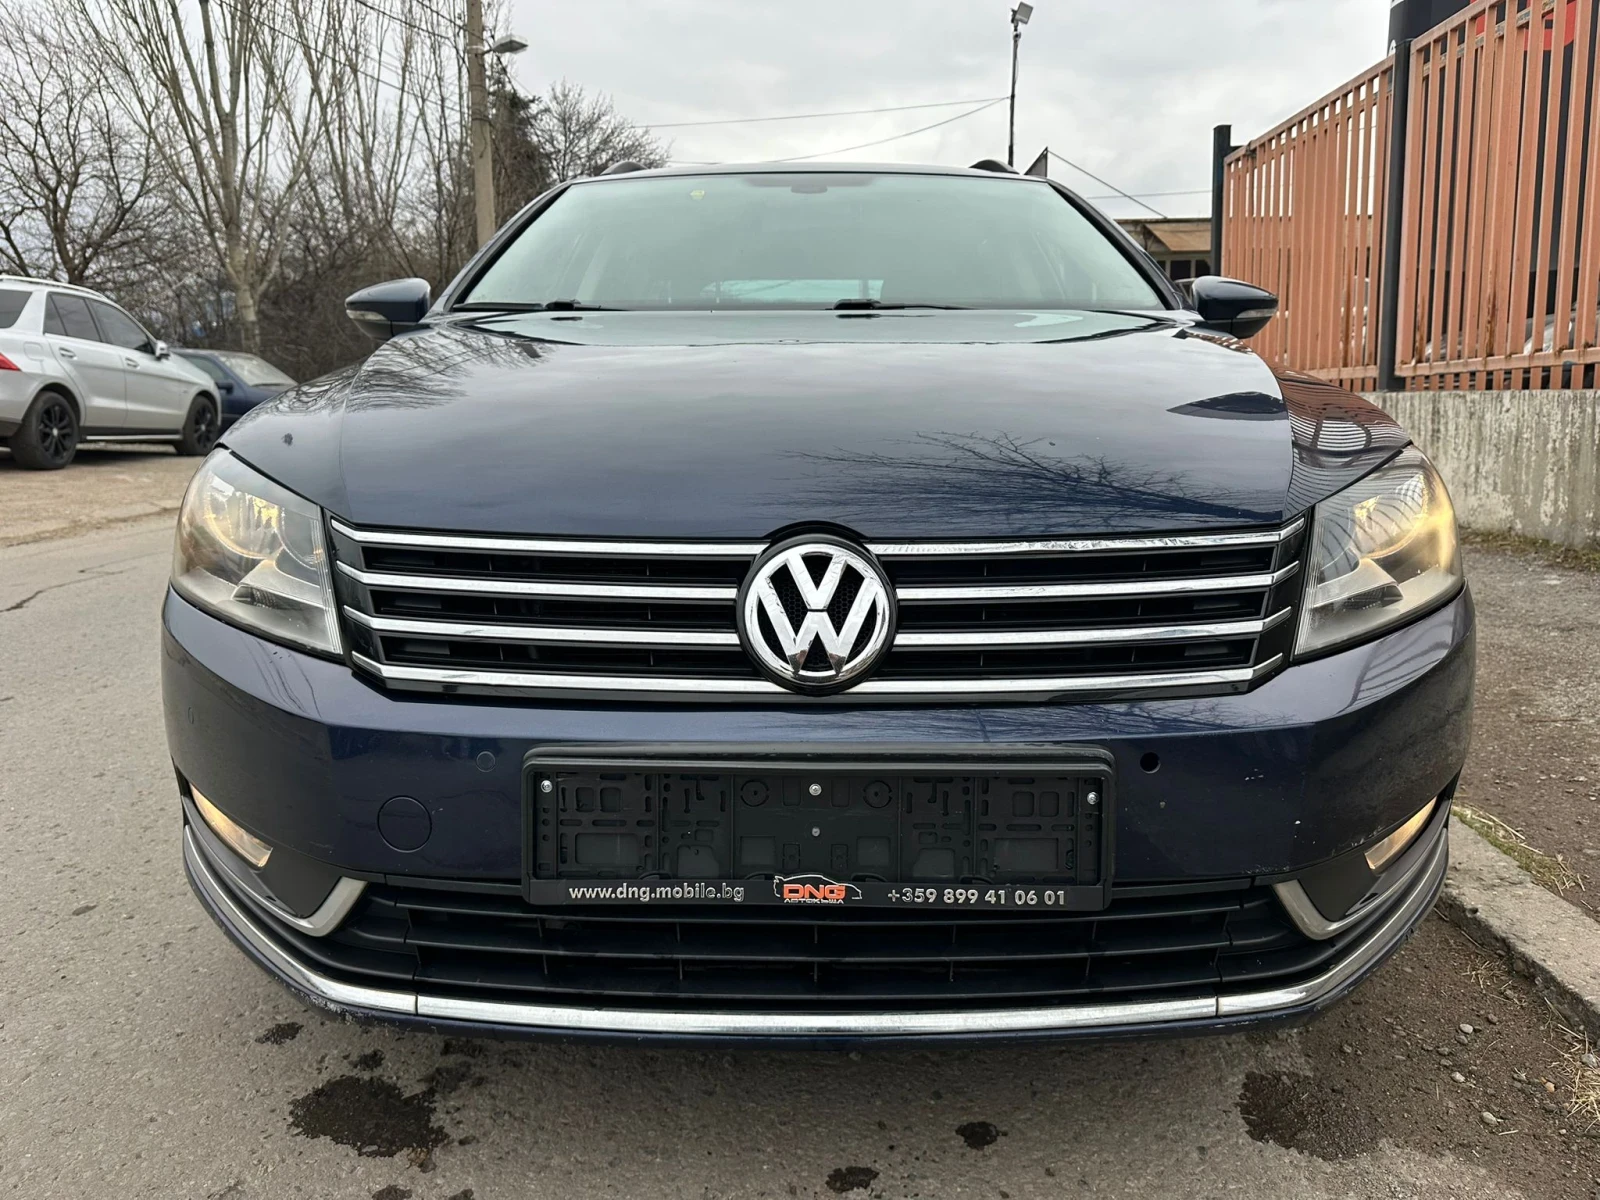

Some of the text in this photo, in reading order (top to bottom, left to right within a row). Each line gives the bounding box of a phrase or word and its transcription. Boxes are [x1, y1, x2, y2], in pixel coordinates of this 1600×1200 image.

[750, 544, 886, 680] VW
[568, 882, 745, 902] www.dng.mobile.bg
[783, 883, 846, 899] DNG
[887, 887, 1066, 905] +359 899 41 06 01
